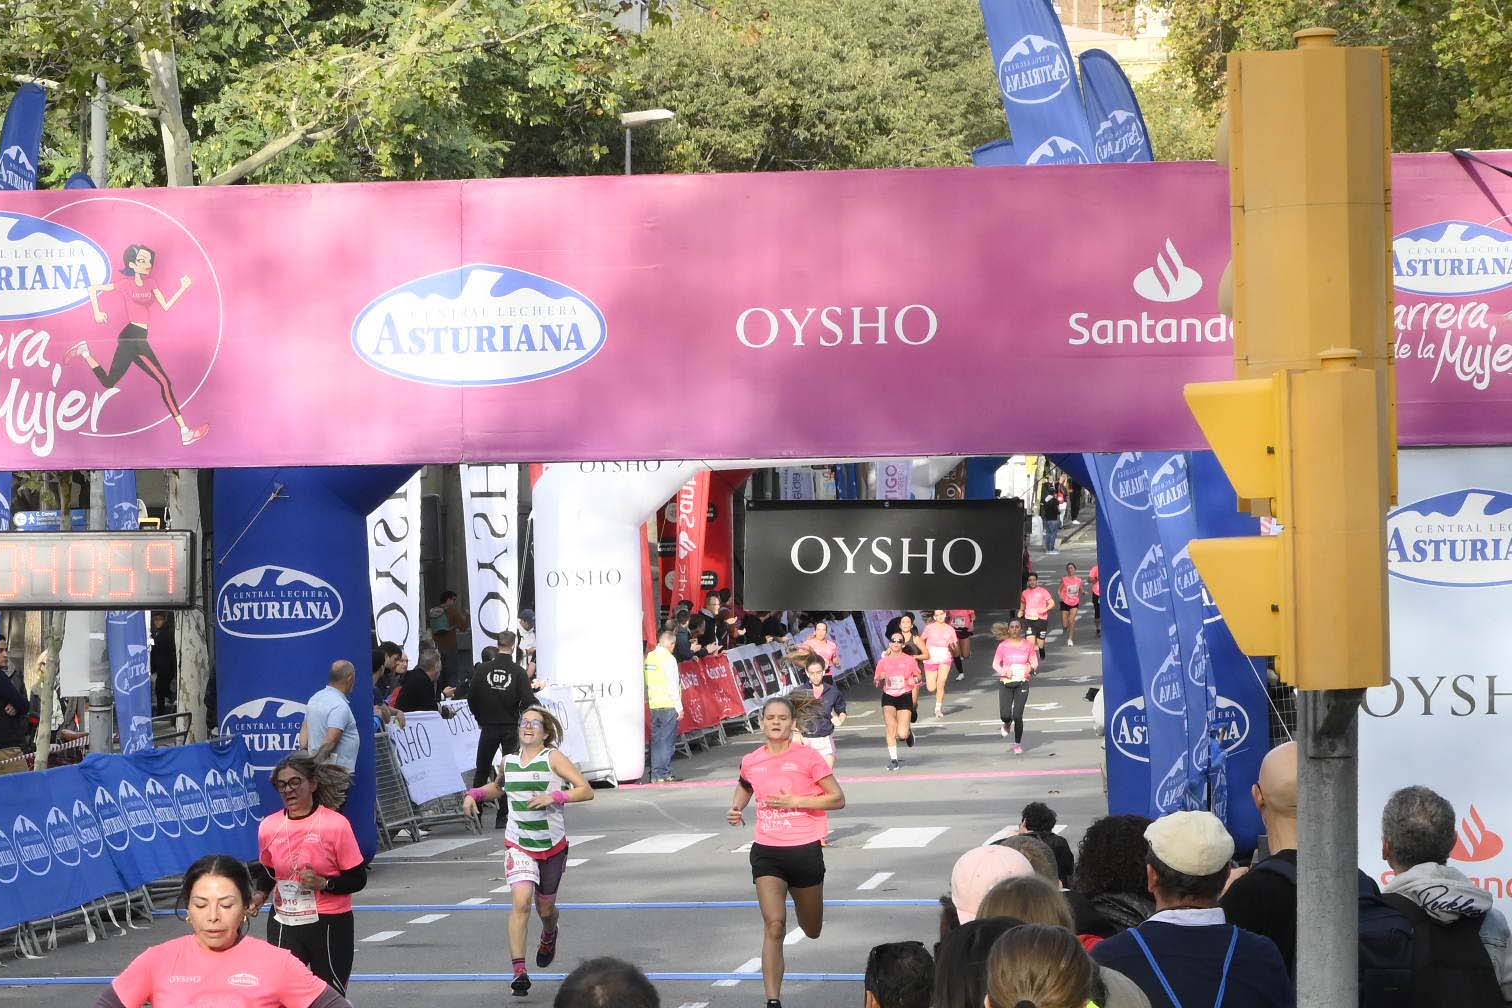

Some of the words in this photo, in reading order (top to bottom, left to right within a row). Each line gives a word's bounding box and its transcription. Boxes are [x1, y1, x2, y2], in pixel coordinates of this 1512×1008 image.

[13, 247, 86, 260] LECHERA
[734, 303, 938, 349] OYSHO
[1068, 311, 1234, 345] Santand
[1393, 301, 1490, 331] arrera
[372, 311, 588, 356] ASTURIANA
[1415, 523, 1482, 534] CENTRAL
[790, 534, 984, 577] OYSHO
[233, 589, 275, 600] CENTRAL
[280, 589, 330, 598] LECHERA
[221, 599, 334, 623] ASTURIANA
[235, 721, 276, 731] CENTRAL
